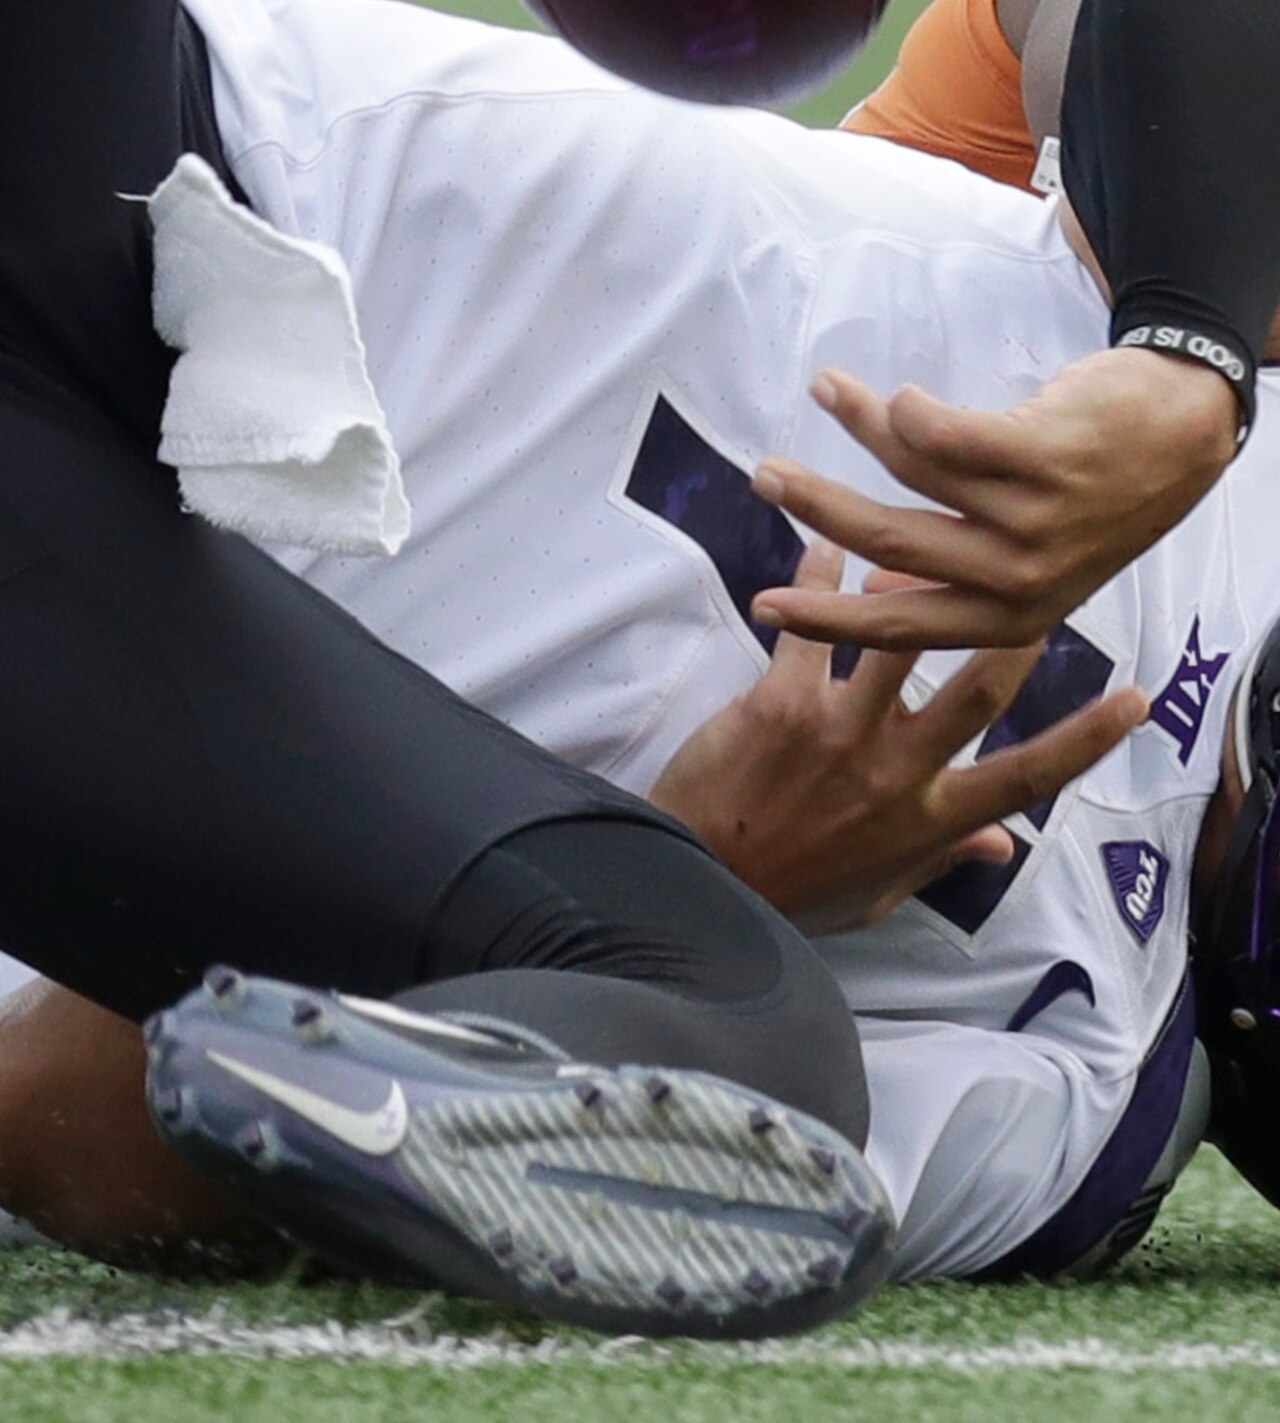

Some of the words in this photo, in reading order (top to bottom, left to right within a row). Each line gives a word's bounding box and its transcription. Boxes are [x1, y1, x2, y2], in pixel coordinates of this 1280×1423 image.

[1153, 326, 1185, 348] IS
[1186, 335, 1245, 381] GOD
[1149, 611, 1233, 768] XII
[1124, 848, 1159, 922] TCU
